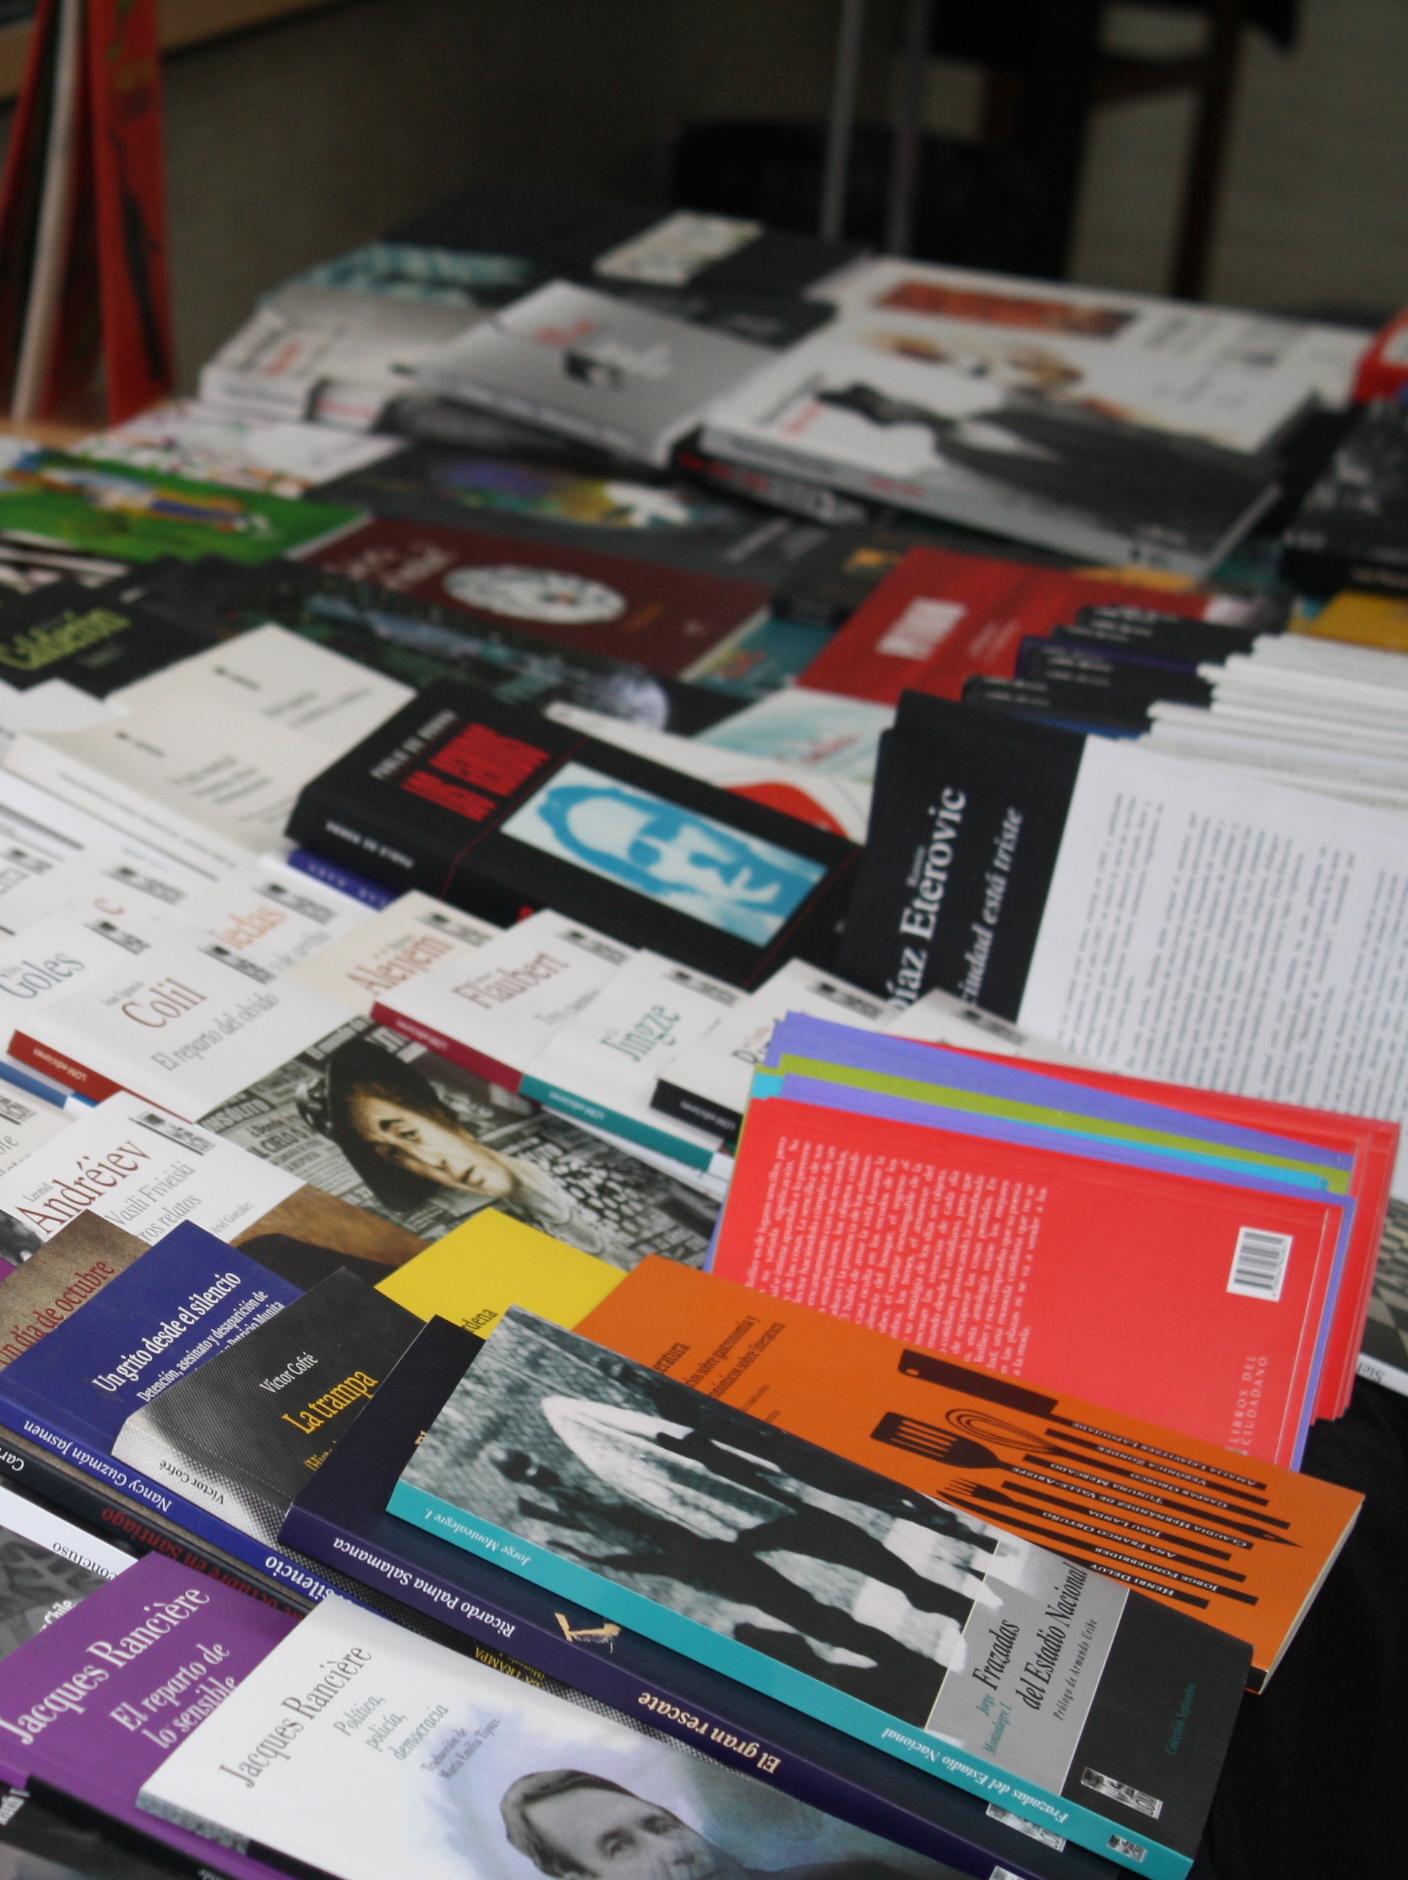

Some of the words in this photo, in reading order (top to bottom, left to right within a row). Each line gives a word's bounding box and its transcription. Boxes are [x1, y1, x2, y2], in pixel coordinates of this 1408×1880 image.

[994, 806, 1023, 872] triste
[898, 786, 967, 941] Eterovic
[983, 871, 1007, 926] está
[453, 950, 571, 1010] Flaubert
[172, 1031, 220, 1063] reparto
[216, 1015, 240, 1037] del
[238, 993, 279, 1026] olvido
[601, 1003, 681, 1062] Jingze
[15, 1138, 152, 1235] Andréiev
[912, 1186, 933, 1234] amanecer
[12, 1318, 46, 1346] día
[37, 1305, 66, 1329] de
[57, 1258, 116, 1315] octubre
[177, 1303, 200, 1328] el
[188, 1270, 242, 1319] silencio
[905, 1276, 925, 1320] nostalgia
[116, 1336, 152, 1383] grito
[141, 1316, 187, 1361] desde
[92, 1362, 124, 1395] Un
[258, 1373, 293, 1394] Víctor
[288, 1352, 319, 1377] Cofré
[281, 1407, 323, 1435] La
[310, 1370, 379, 1410] trampa
[1230, 1389, 1248, 1444] LIBROS
[1243, 1356, 1257, 1382] DEL
[1242, 1356, 1269, 1446] CIUDADANO
[22, 1420, 73, 1454] Jasmen
[68, 1444, 139, 1488] Guzmán
[131, 1477, 174, 1513] Nancy
[332, 1537, 412, 1587] Salamanca
[1088, 1562, 1132, 1582] DELUY
[412, 1577, 462, 1609] Palma
[1045, 1561, 1087, 1628] Nacional
[1132, 1576, 1176, 1597] HENRI
[98, 1587, 211, 1666] Rancière
[459, 1606, 516, 1637] Ricardo
[972, 1619, 1020, 1691] Frazadas
[1024, 1629, 1067, 1685] Estadio
[108, 1702, 149, 1732] El
[141, 1656, 208, 1712] reparto
[196, 1642, 232, 1672] de
[1015, 1671, 1047, 1711] del
[141, 1723, 177, 1750] lo
[170, 1675, 237, 1739] sensible
[218, 1711, 305, 1789] Jacques
[287, 1644, 373, 1715] Rancière
[334, 1695, 385, 1738] Política,
[364, 1713, 408, 1752] policía,
[392, 1705, 449, 1760] democracia
[638, 1691, 714, 1736] rescate
[710, 1726, 758, 1765] gran
[754, 1751, 782, 1774] El
[880, 1727, 949, 1768] Nacional
[949, 1763, 989, 1790] Estadio
[985, 1779, 1010, 1798] del
[1010, 1790, 1068, 1824] Frazadas
